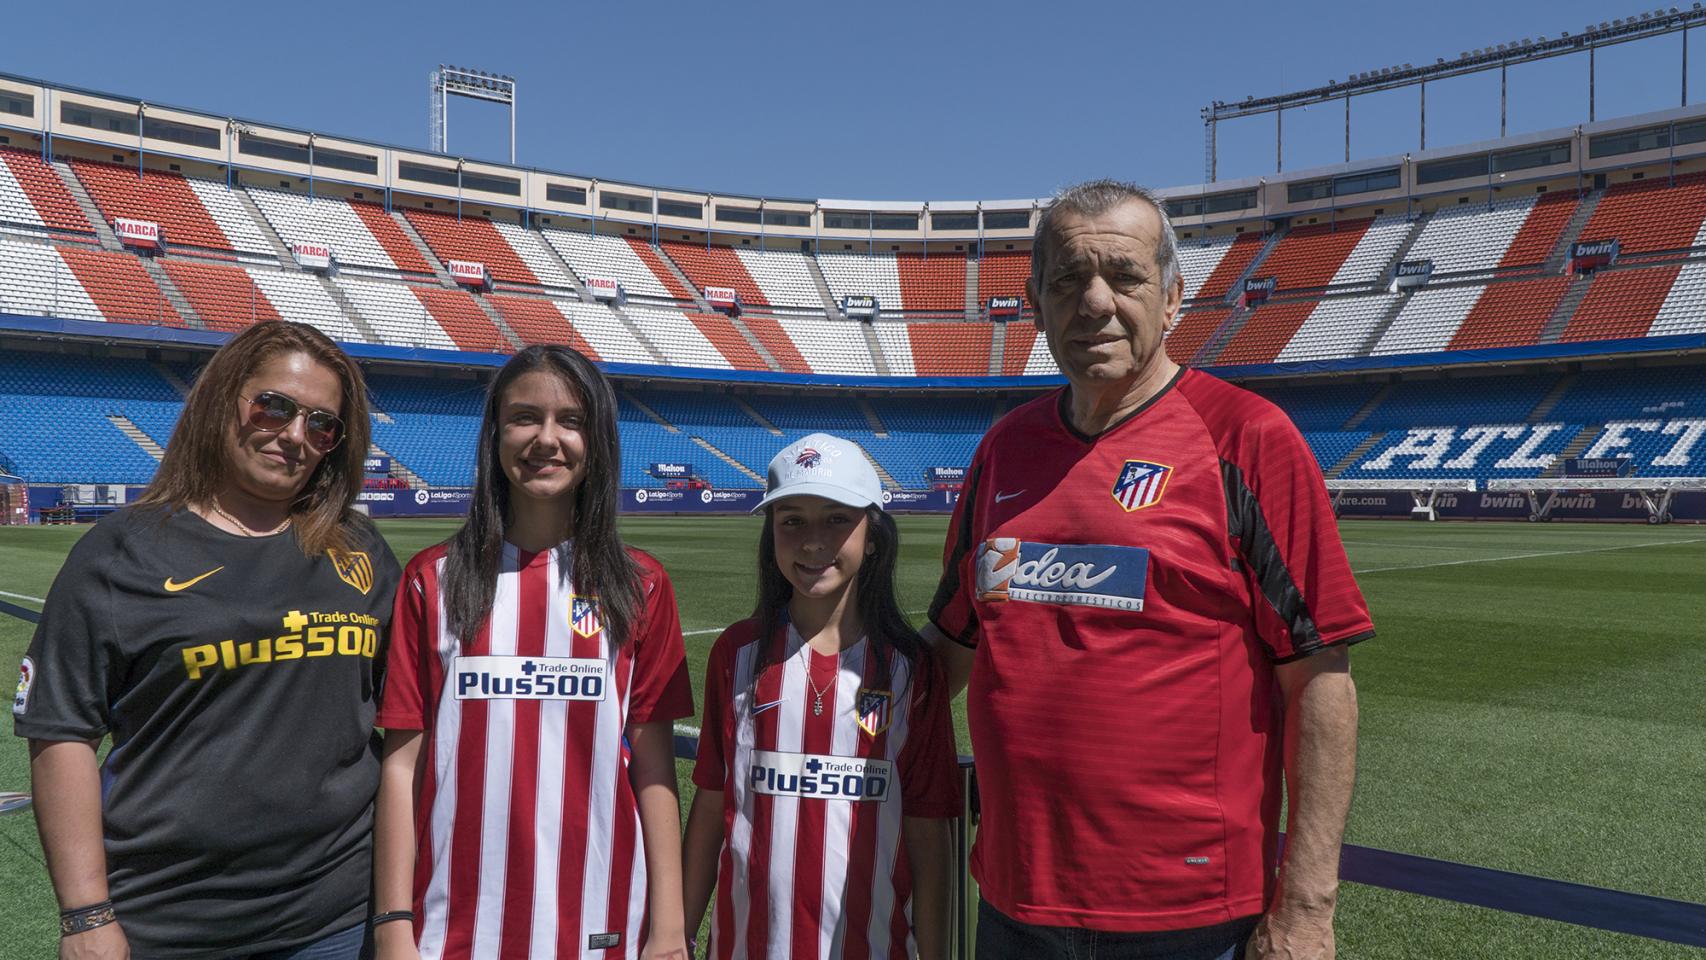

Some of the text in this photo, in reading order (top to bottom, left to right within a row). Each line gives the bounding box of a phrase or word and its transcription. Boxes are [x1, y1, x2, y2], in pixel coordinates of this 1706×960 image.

[116, 222, 156, 237] MARCA
[293, 244, 329, 257] MARCA
[1576, 241, 1613, 256] bwin
[451, 264, 481, 275] MARCA
[587, 278, 616, 289] MARCA
[1247, 279, 1273, 291] bwin
[706, 290, 733, 300] MARCA
[847, 297, 873, 307] bwin
[992, 297, 1018, 308] bwin
[1339, 497, 1387, 506] ore.com
[1480, 493, 1525, 508] bwin
[1011, 591, 1142, 611] ELECTRODOMESTICOS
[309, 611, 379, 627] Trade Online
[182, 626, 377, 680] Plus500
[539, 663, 604, 674] Trade Online
[458, 672, 602, 697] Plus500
[824, 762, 888, 775] Trade Online
[751, 765, 886, 797] Plus500
